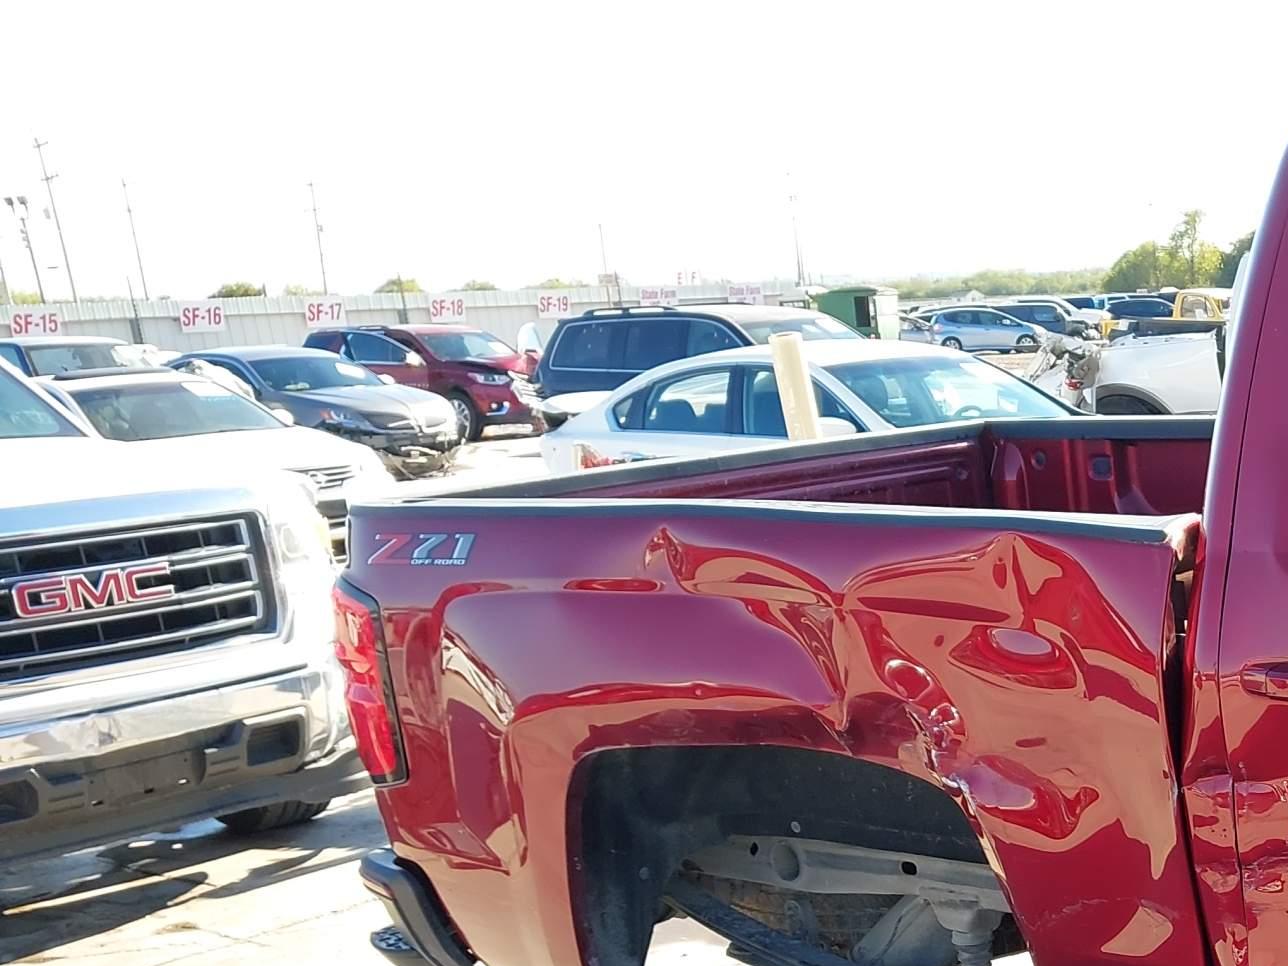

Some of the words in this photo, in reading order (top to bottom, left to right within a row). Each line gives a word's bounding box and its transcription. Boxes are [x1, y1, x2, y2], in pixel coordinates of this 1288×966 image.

[307, 303, 342, 322] SF-17
[430, 299, 464, 317] SF-18
[539, 296, 569, 313] SF-19
[13, 313, 59, 335] SF-15
[182, 306, 222, 327] SF-16
[368, 533, 476, 565] Z71
[12, 562, 175, 618] GMC
